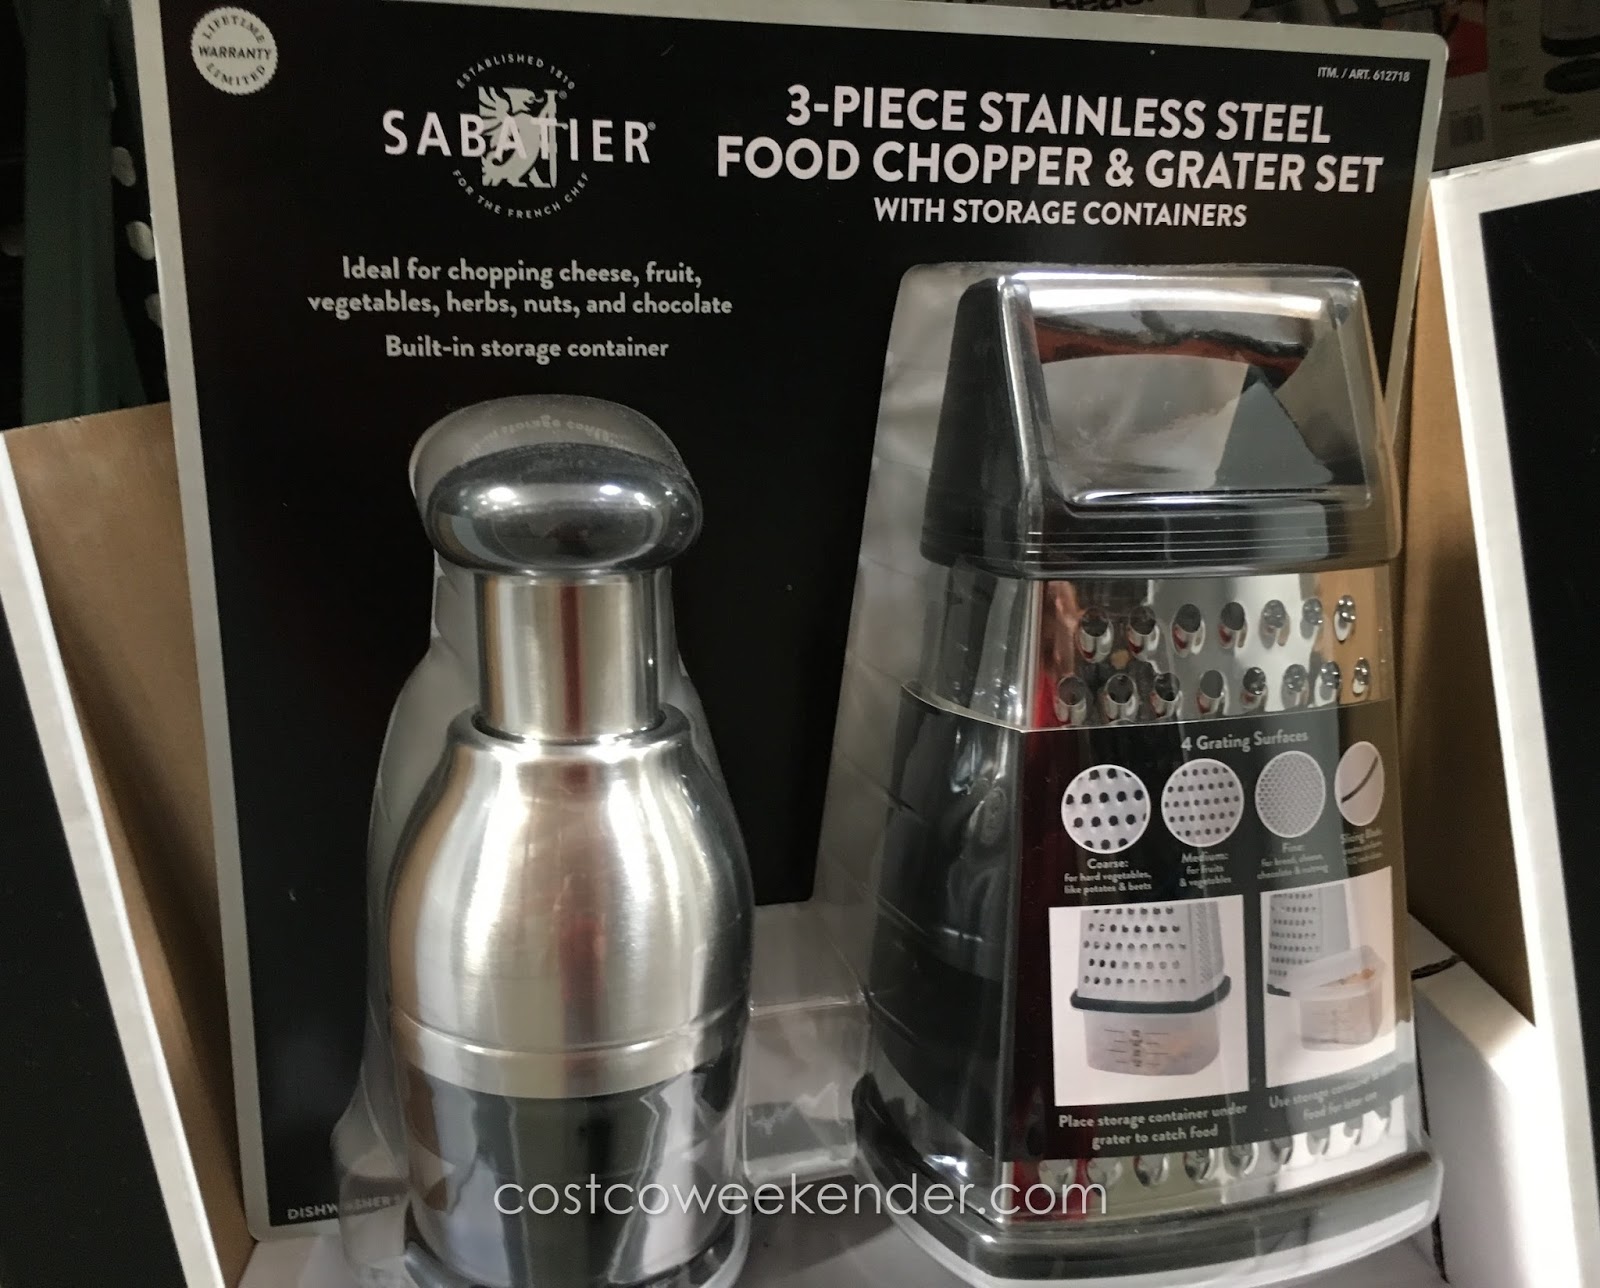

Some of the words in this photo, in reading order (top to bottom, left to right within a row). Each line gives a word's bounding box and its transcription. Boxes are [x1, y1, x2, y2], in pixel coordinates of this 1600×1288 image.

[202, 15, 265, 43] LIFETIME
[198, 46, 271, 60] WARRANTY
[206, 63, 265, 85] LIMITED
[456, 54, 544, 89] ESTABLISHED
[1317, 67, 1339, 79] ITM.
[1348, 69, 1371, 80] ART.
[1373, 70, 1411, 82] 612718
[786, 84, 967, 131] 3-PIECE
[978, 91, 1206, 139] STAINLESS
[1215, 101, 1331, 144] STEEL
[382, 110, 651, 164] SABATIER
[717, 135, 860, 180] FOOD
[873, 140, 1093, 186] CHOPPER
[1104, 148, 1134, 188] &
[1145, 149, 1305, 191] GRATER
[1314, 155, 1384, 194] SET
[452, 169, 474, 195] FOR
[477, 195, 501, 214] THE
[507, 201, 561, 219] FRENCH
[564, 172, 589, 202] CHEF
[874, 197, 945, 223] WITH
[952, 199, 1077, 225] STORAGE
[1082, 201, 1248, 227] CONTAINERS
[343, 256, 400, 280] Ideal
[407, 257, 441, 280] for
[447, 257, 553, 289] chopping
[559, 260, 640, 287] cheese,
[646, 261, 702, 287] fruit,
[307, 289, 440, 320] vegetables,
[447, 290, 517, 317] herbs,
[524, 296, 580, 317] nuts,
[586, 292, 626, 314] and
[633, 292, 733, 315] chocolate
[386, 335, 475, 358] Built-in
[481, 339, 561, 365] storage
[568, 336, 669, 358] container
[1181, 737, 1192, 751] 4
[1196, 734, 1251, 752] Grating
[1253, 729, 1308, 746] Surfaces
[1064, 873, 1078, 882] for
[1087, 858, 1129, 869] Coarse:
[1186, 866, 1200, 875] for
[1059, 1114, 1095, 1128] Place
[1097, 1113, 1145, 1129] storage
[1148, 1108, 1209, 1124] container
[1212, 1102, 1248, 1117] under
[1092, 1133, 1132, 1150] grater
[1135, 1131, 1148, 1144] to
[1152, 1126, 1187, 1142] catch
[1190, 1124, 1218, 1138] food
